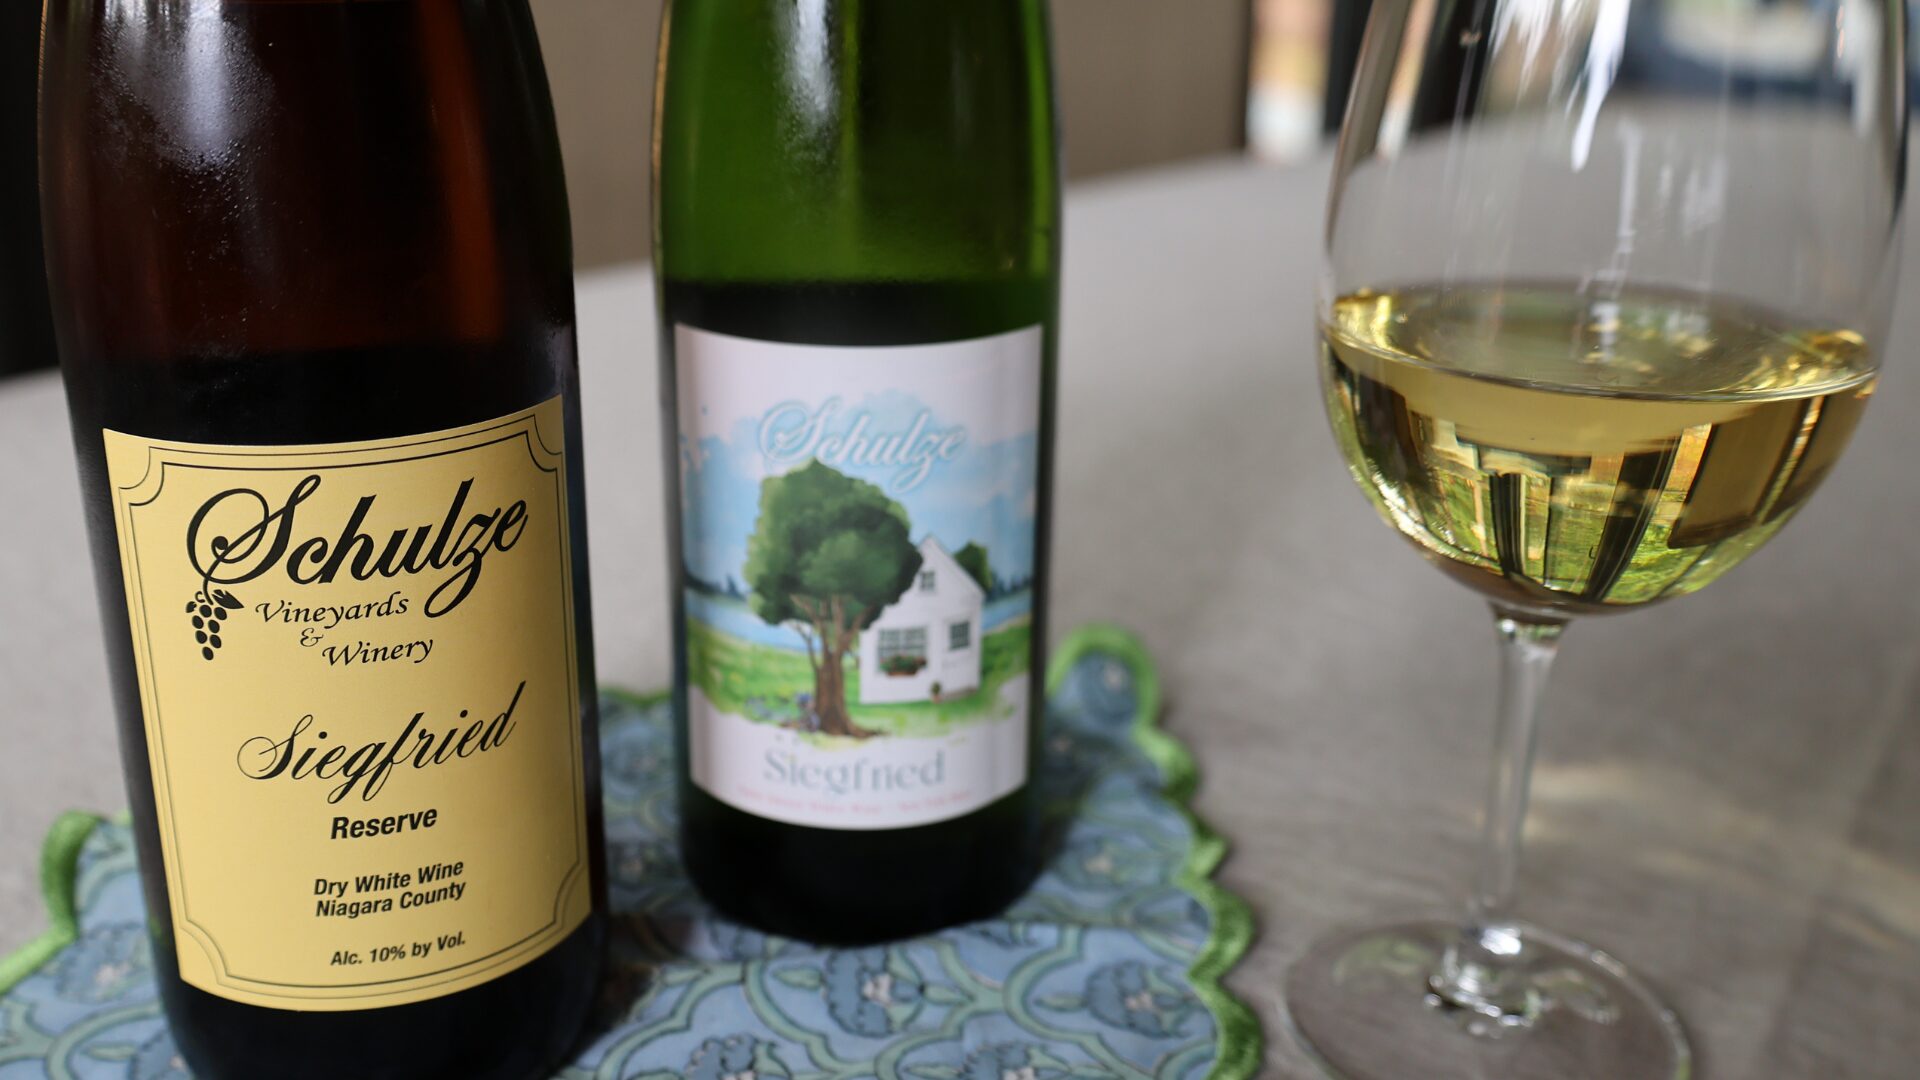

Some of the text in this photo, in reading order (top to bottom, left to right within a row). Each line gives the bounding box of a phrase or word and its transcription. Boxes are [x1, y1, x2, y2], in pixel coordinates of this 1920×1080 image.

[759, 396, 966, 494] Schulze
[186, 474, 529, 618] Schulze
[255, 591, 410, 629] Vineyards
[299, 628, 324, 647] &
[321, 638, 434, 666] Winery
[236, 680, 527, 804] Siegfried
[763, 748, 946, 795] Siegfried
[330, 808, 438, 840] Reserve
[313, 860, 464, 899] Dry White Wine
[315, 882, 466, 919] Niagara County
[330, 931, 465, 966] Alc. 10% by Vol.
